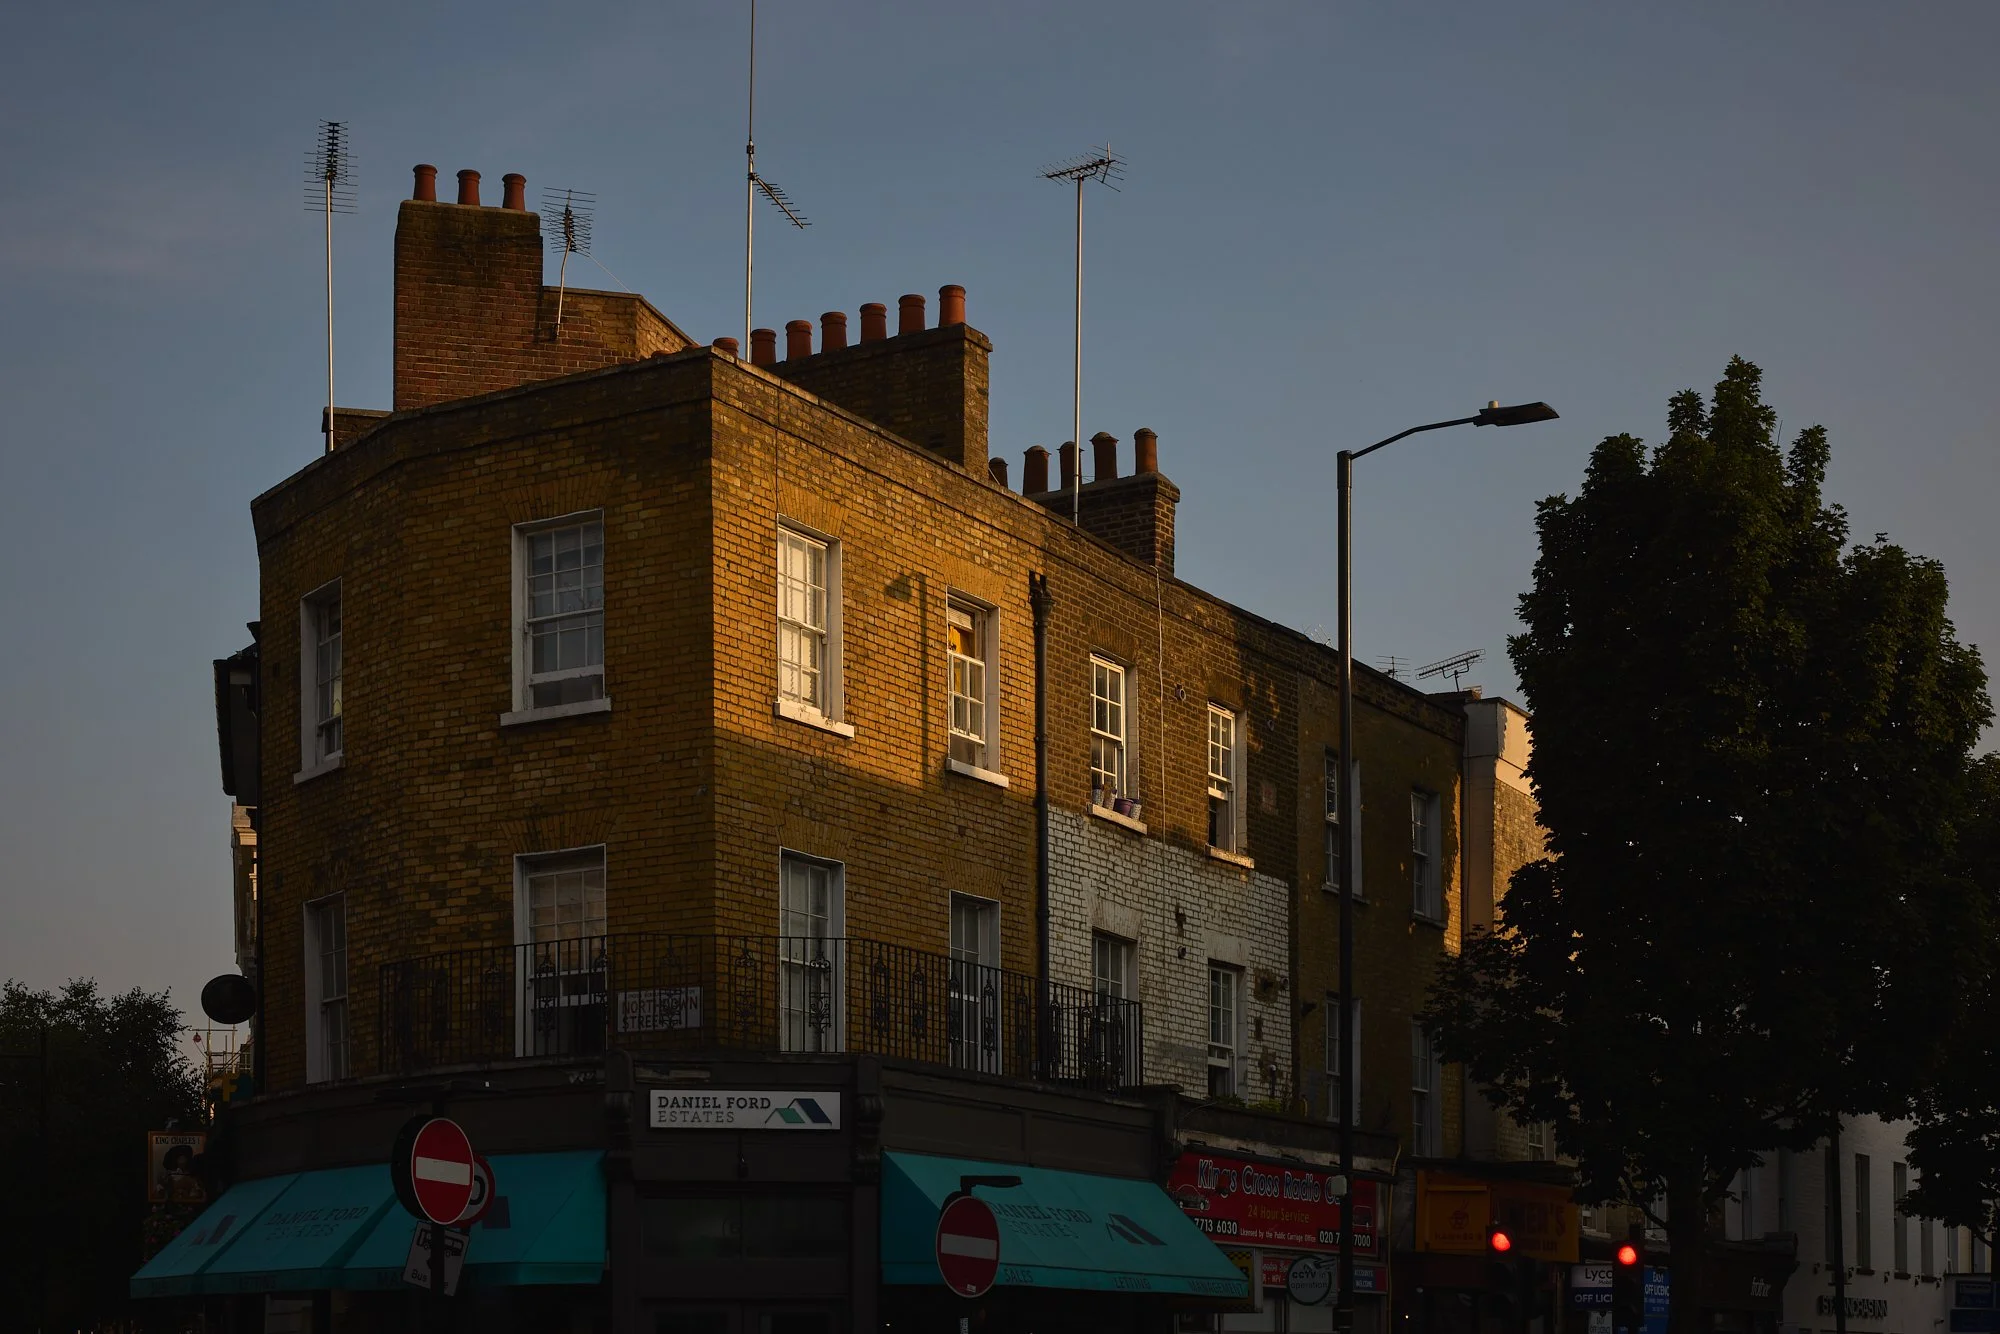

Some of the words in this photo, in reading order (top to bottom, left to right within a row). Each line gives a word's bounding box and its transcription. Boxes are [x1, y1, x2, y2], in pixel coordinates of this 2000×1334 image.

[658, 1097, 721, 1109] DANIEL
[727, 1097, 771, 1109] FORD
[658, 1110, 735, 1123] ESTATES
[155, 1136, 169, 1145] KING
[171, 1136, 195, 1145] CHARLES
[1242, 1165, 1280, 1198] Cross
[1284, 1171, 1321, 1203] Radio
[324, 1206, 369, 1221] FORD
[1048, 1207, 1092, 1224] FORD
[1248, 1204, 1258, 1217] 24
[1260, 1205, 1279, 1220] Hour
[1281, 1208, 1310, 1224] Service
[1217, 1219, 1238, 1235] 6030
[1240, 1228, 1258, 1238] Licensed
[1259, 1230, 1265, 1240] by
[1266, 1230, 1274, 1239] the
[1275, 1231, 1287, 1240] Public
[1288, 1232, 1304, 1243] Carriage
[1305, 1234, 1317, 1243] Office
[1320, 1230, 1334, 1244] 020
[1353, 1234, 1371, 1248] 7000
[411, 1268, 428, 1283] Bus
[1005, 1269, 1034, 1283] SALES
[1113, 1277, 1152, 1290] LETTING
[1189, 1280, 1243, 1297] MANAGEMENT
[1290, 1281, 1329, 1290] operation
[1574, 1293, 1593, 1303] OFF
